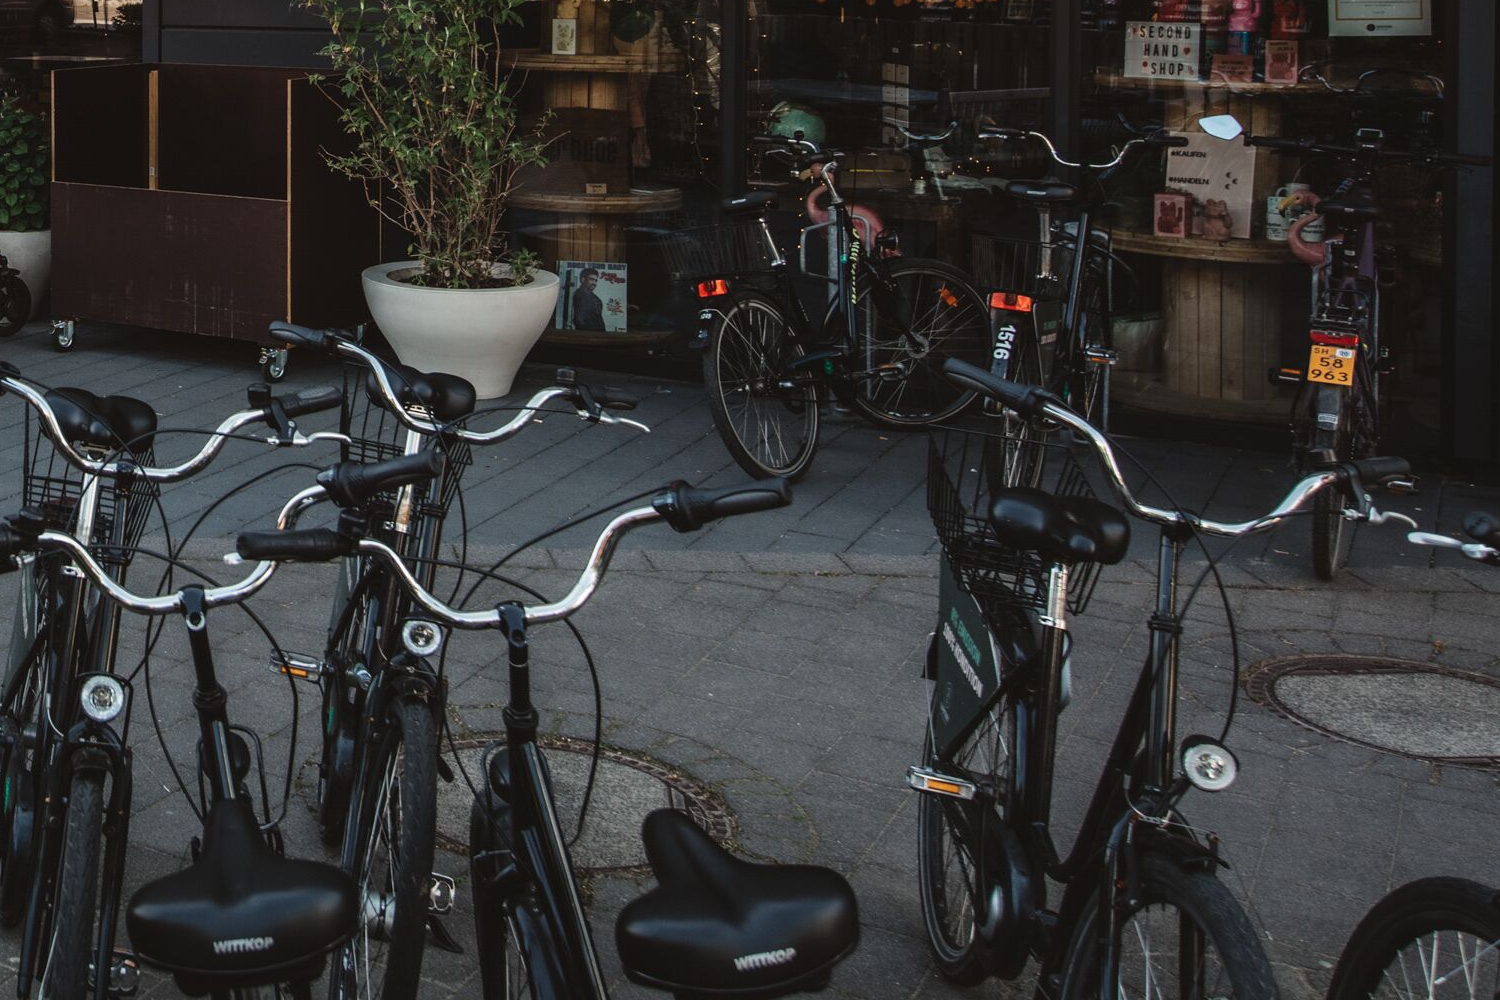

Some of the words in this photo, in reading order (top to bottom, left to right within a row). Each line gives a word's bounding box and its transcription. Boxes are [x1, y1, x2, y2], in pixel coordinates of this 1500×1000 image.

[1139, 25, 1191, 40] SECOND
[1144, 44, 1179, 58] HAND
[1151, 62, 1184, 76] SHOP
[993, 324, 1017, 361] 1516
[1319, 357, 1344, 369] 58
[1311, 369, 1349, 382] 963
[213, 936, 275, 954] WITTKOP
[734, 947, 797, 971] WITTKOP
